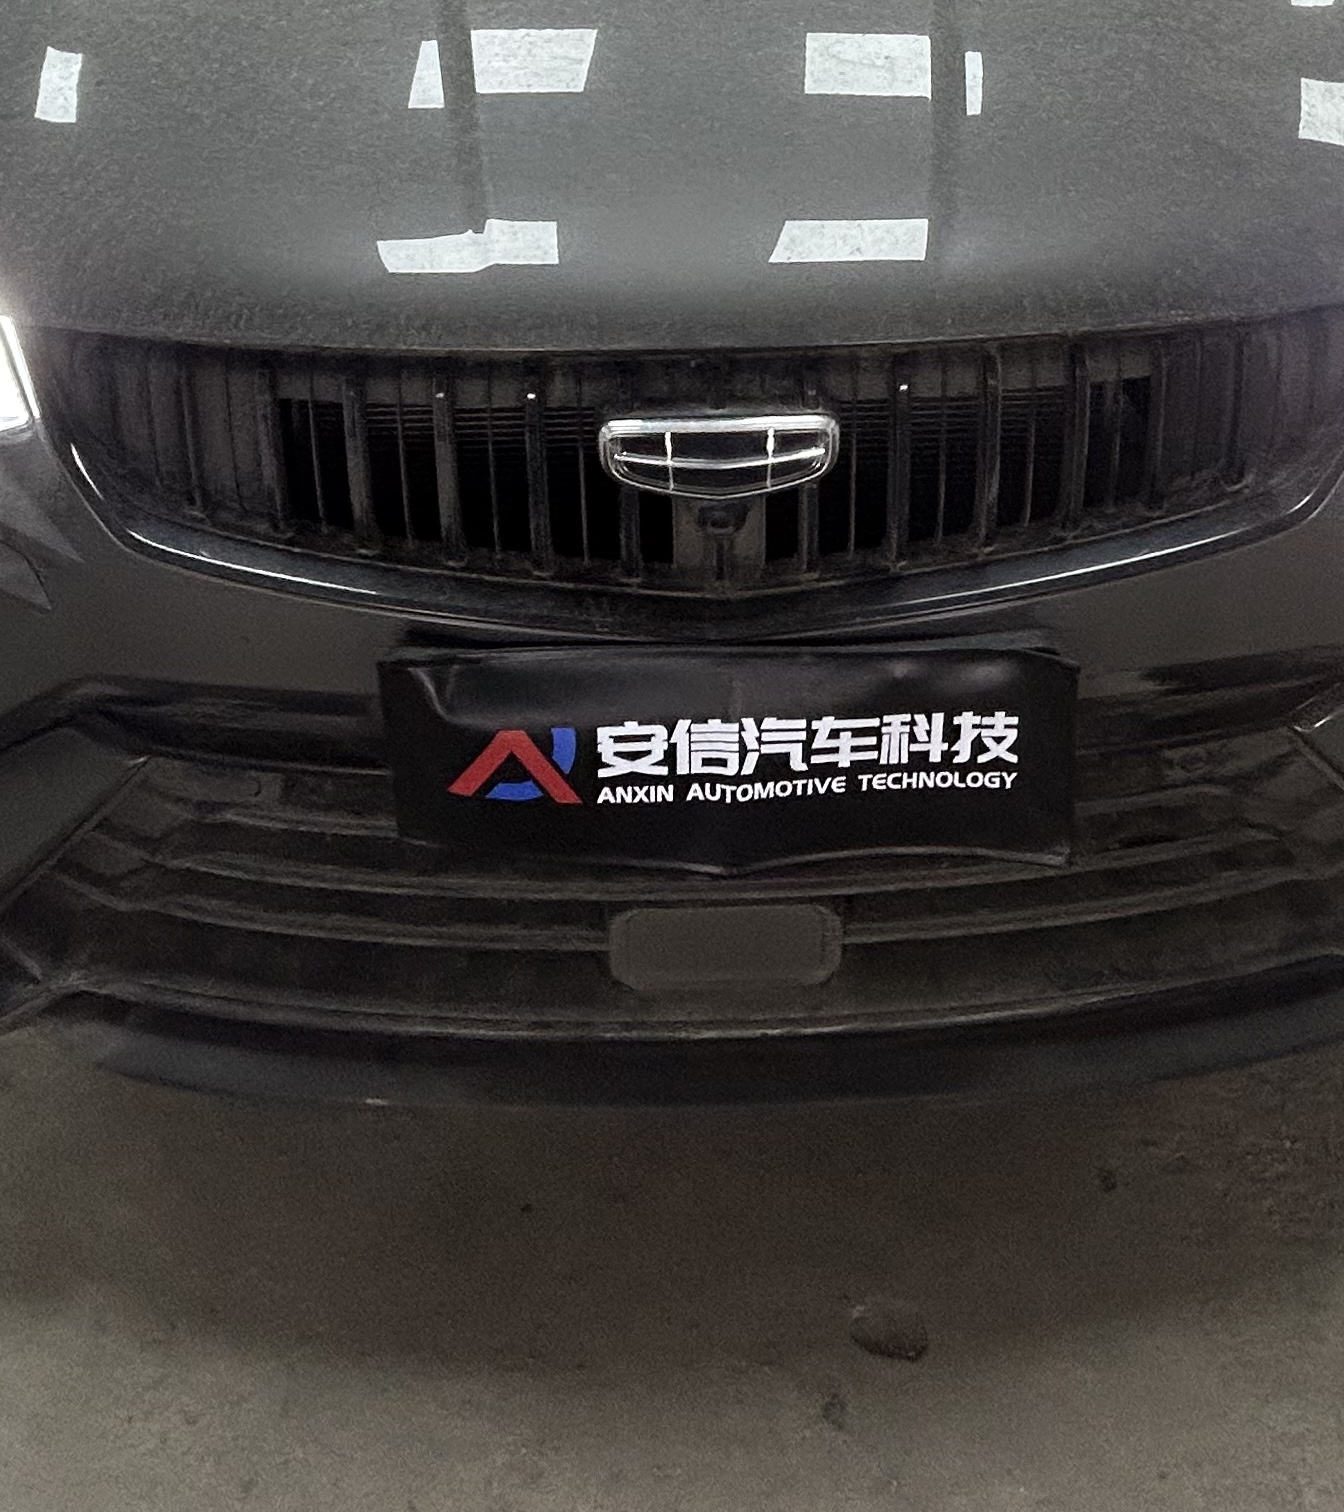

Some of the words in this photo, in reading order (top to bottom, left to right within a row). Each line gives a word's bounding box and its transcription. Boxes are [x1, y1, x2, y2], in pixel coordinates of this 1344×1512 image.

[596, 710, 1019, 778] 安信汽车科技
[596, 784, 674, 804] ANXIN
[686, 775, 847, 804] AUTOMOTIVE
[858, 770, 1018, 792] TECHNOLOGY
